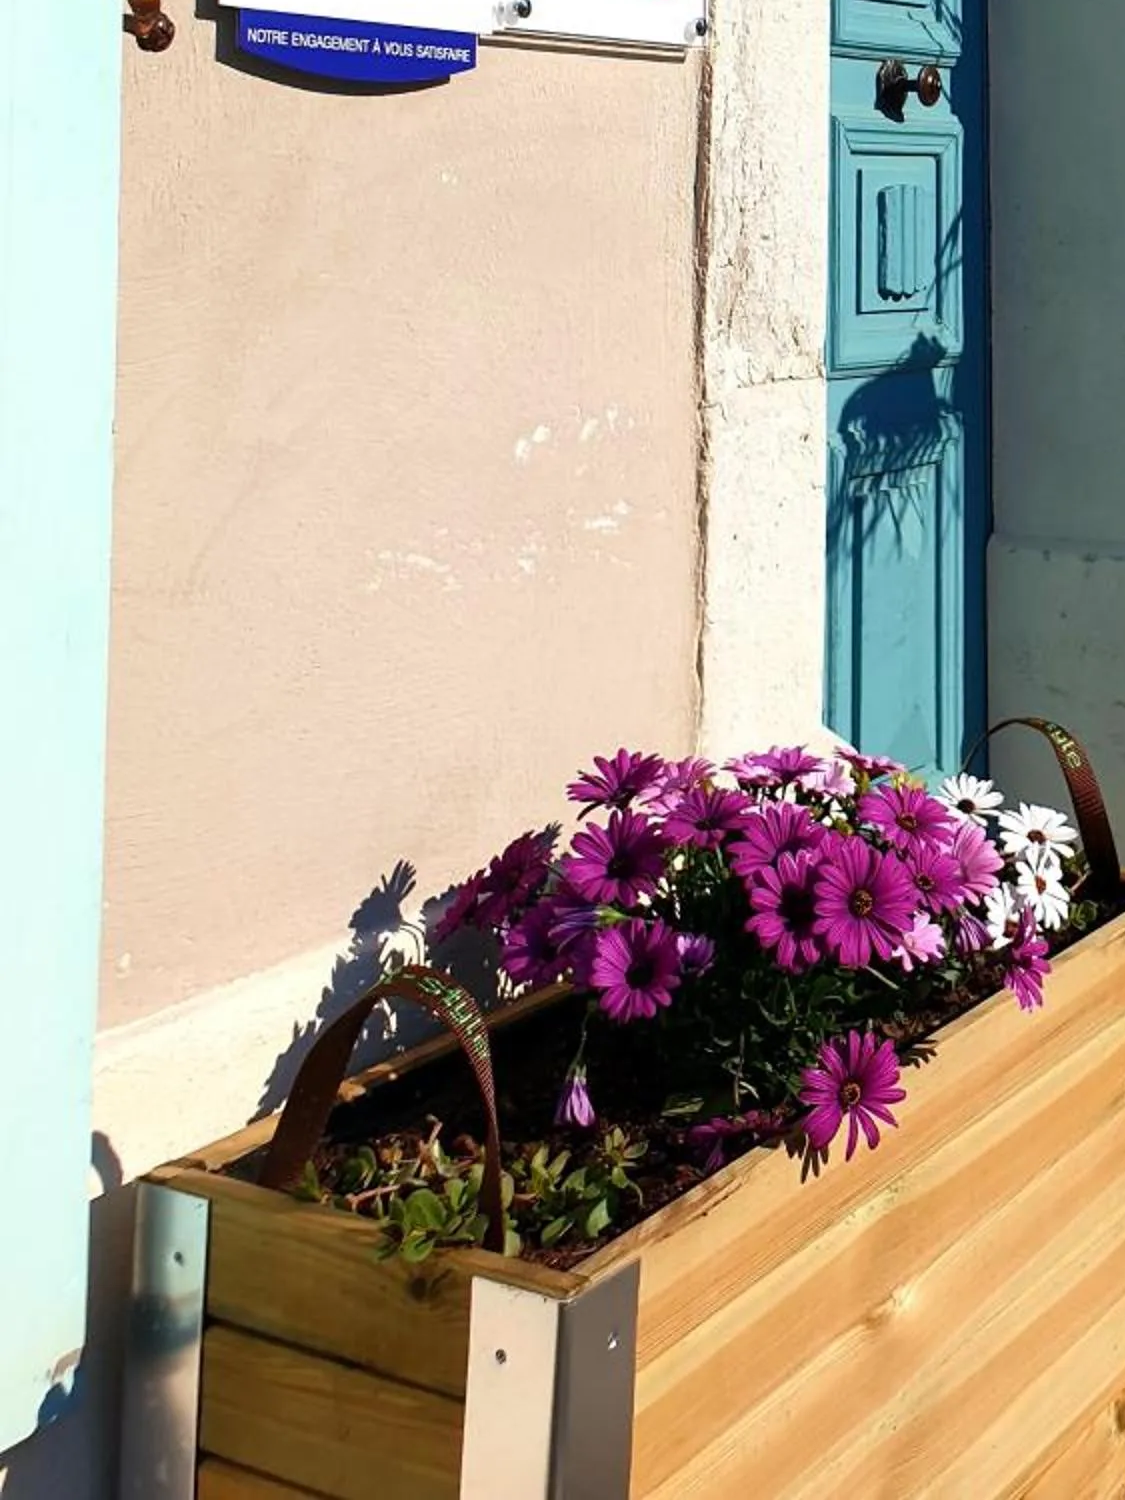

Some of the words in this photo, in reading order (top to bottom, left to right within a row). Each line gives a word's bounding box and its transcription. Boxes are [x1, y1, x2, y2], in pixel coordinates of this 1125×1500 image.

[247, 28, 289, 45] NOTRE
[291, 32, 370, 53] ENGAGEMENT
[373, 37, 381, 56] À
[383, 41, 413, 57] VOUS
[416, 45, 471, 63] SATISFAIRE
